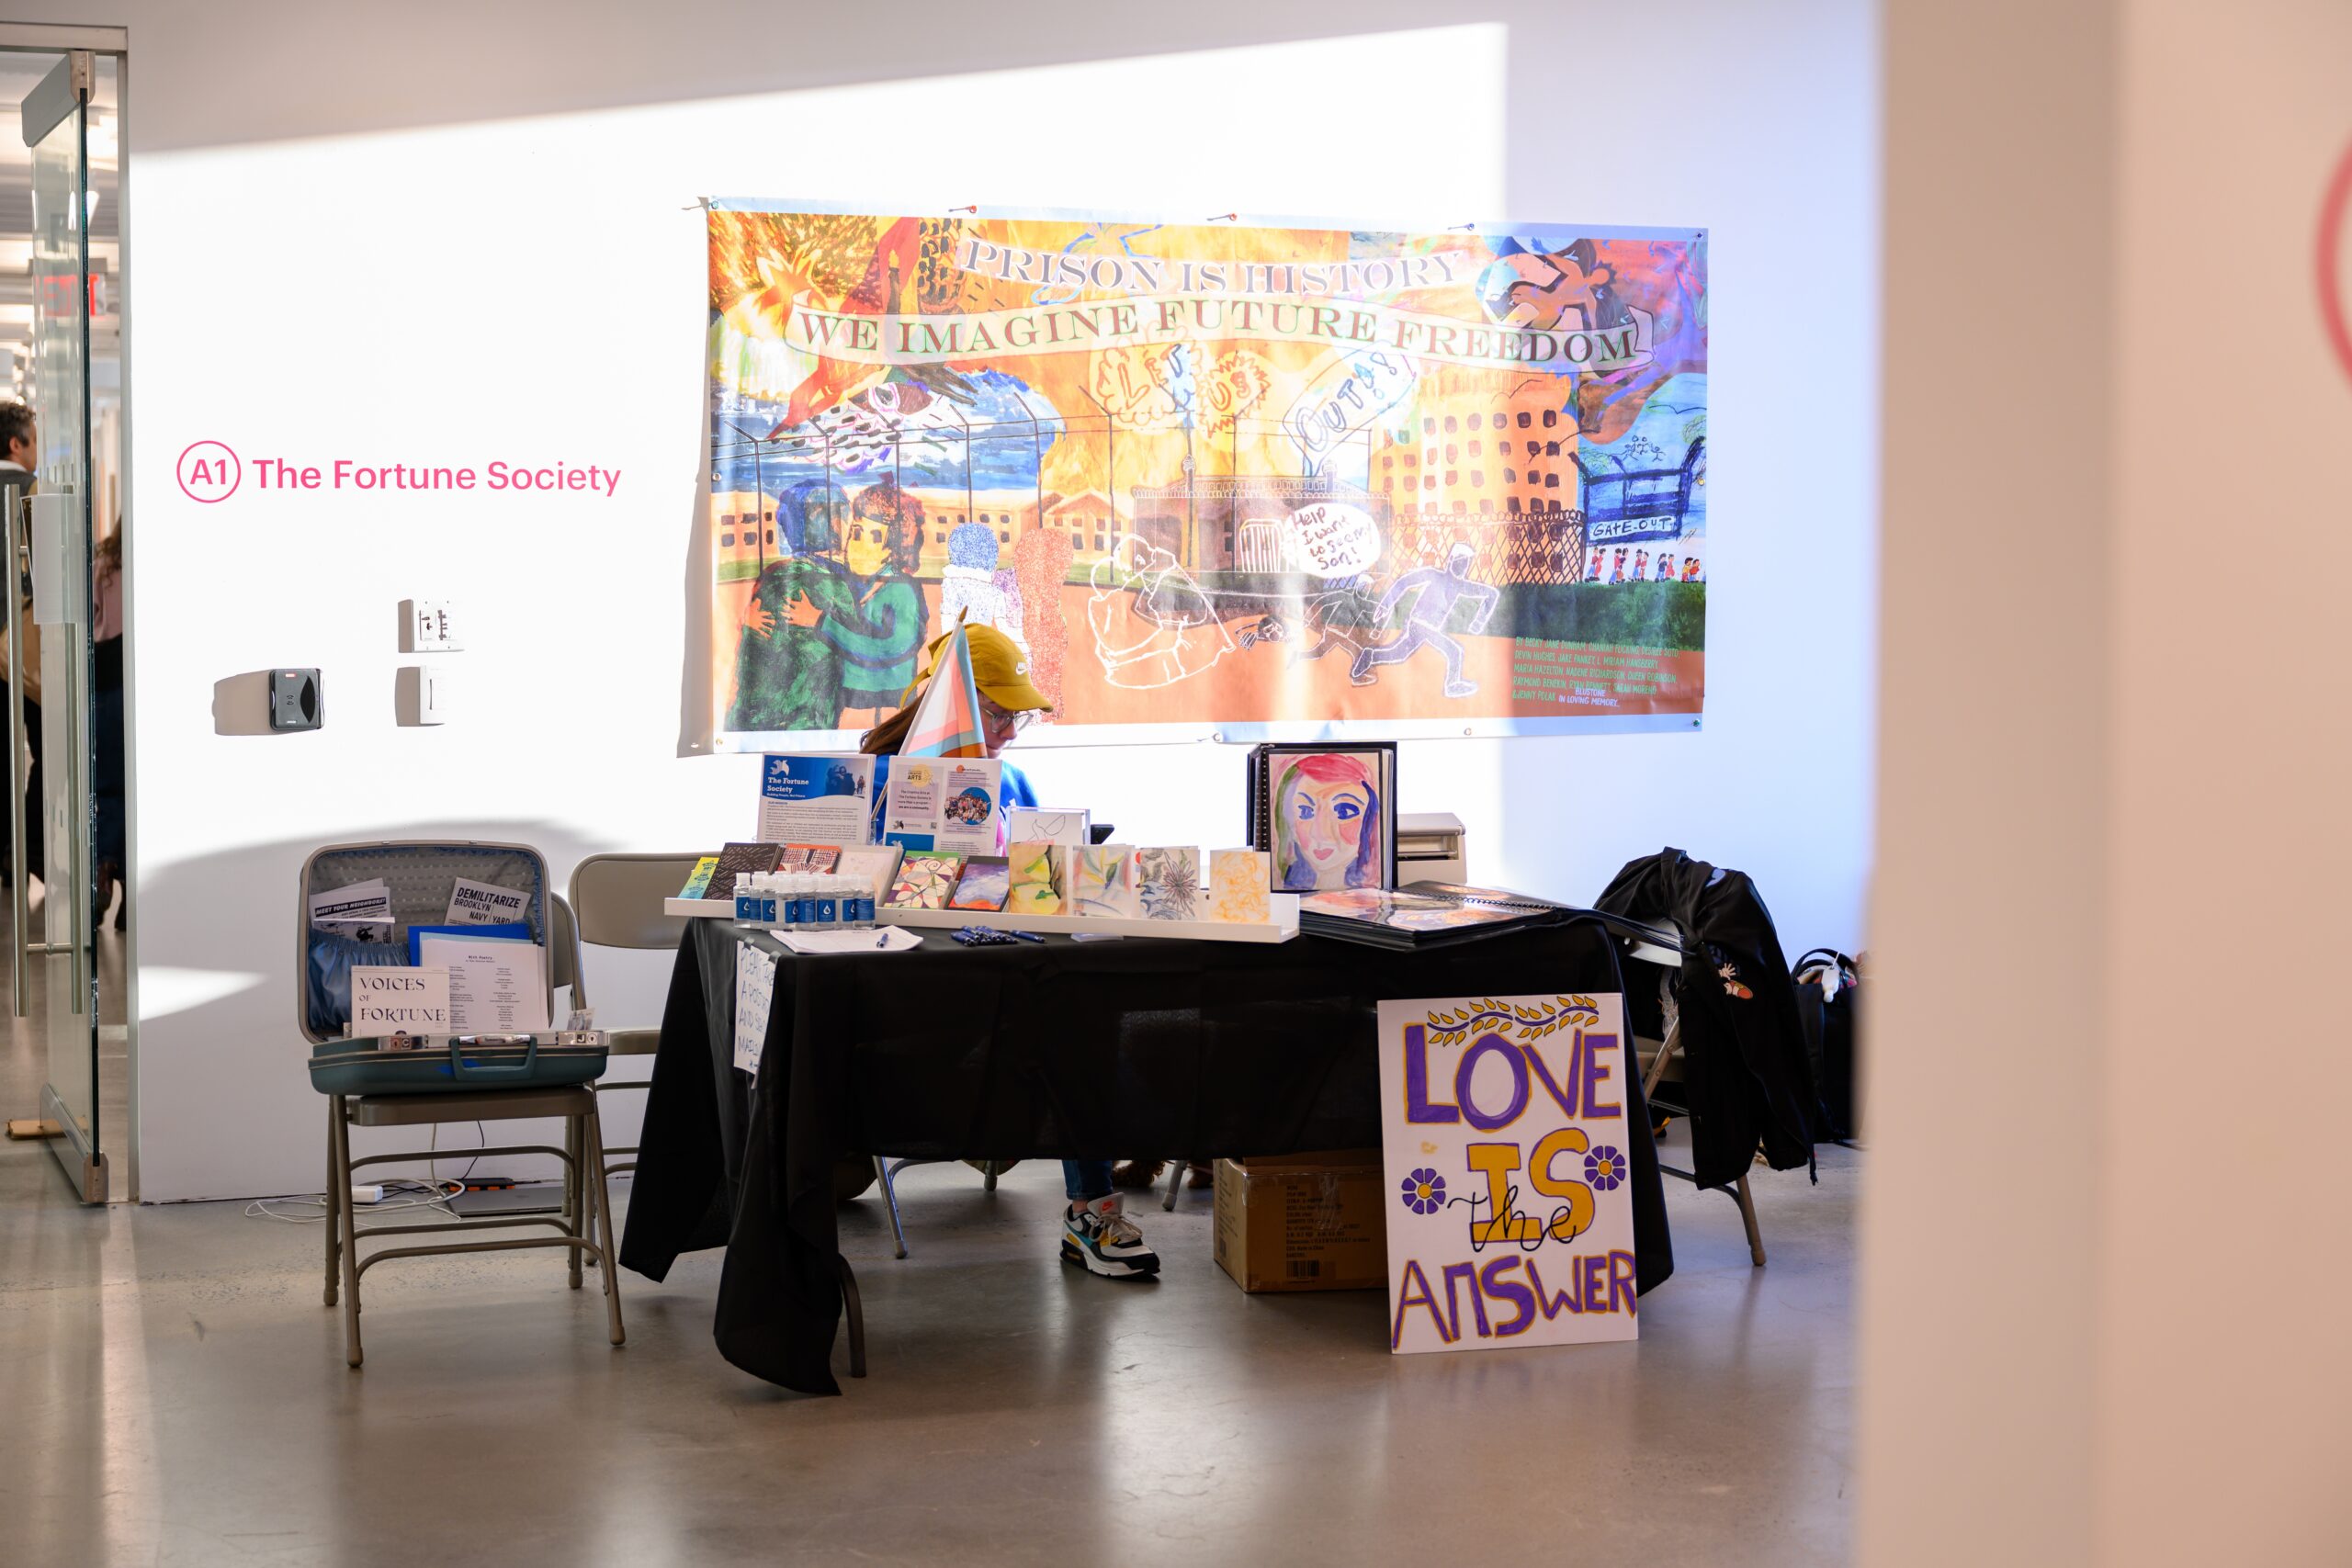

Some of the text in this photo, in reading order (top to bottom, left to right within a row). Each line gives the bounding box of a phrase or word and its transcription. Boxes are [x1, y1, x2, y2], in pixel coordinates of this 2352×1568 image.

[963, 236, 1463, 296] PRISON IS HISTORY
[797, 299, 1636, 363] WE IMAGINE FUTURE FREEDOM
[1208, 370, 1250, 412] US
[189, 458, 622, 497] A1 The Fortune Society
[1294, 506, 1326, 531] Help
[1544, 639, 1559, 649] JANE
[1514, 650, 1532, 660] DEVIN
[1513, 663, 1532, 673] MARIA
[1513, 676, 1541, 687] RAYMOND
[1558, 694, 1566, 704] IN
[1566, 695, 1589, 705] LOVING
[783, 777, 809, 785] Fortune
[766, 784, 793, 794] Society
[457, 887, 521, 908] DEMILITARIZE
[315, 907, 333, 915] MEET
[334, 904, 349, 912] YOUR
[454, 898, 492, 912] BROOKLYN
[469, 911, 489, 922] NAVY
[492, 916, 511, 925] YARD
[359, 977, 425, 991] VOICES
[360, 1008, 447, 1022] FORTUNE
[1402, 1021, 1622, 1133] LOVE
[1466, 1127, 1596, 1245] IS
[1447, 1185, 1577, 1252] the
[1391, 1249, 1637, 1351] ANSWER
